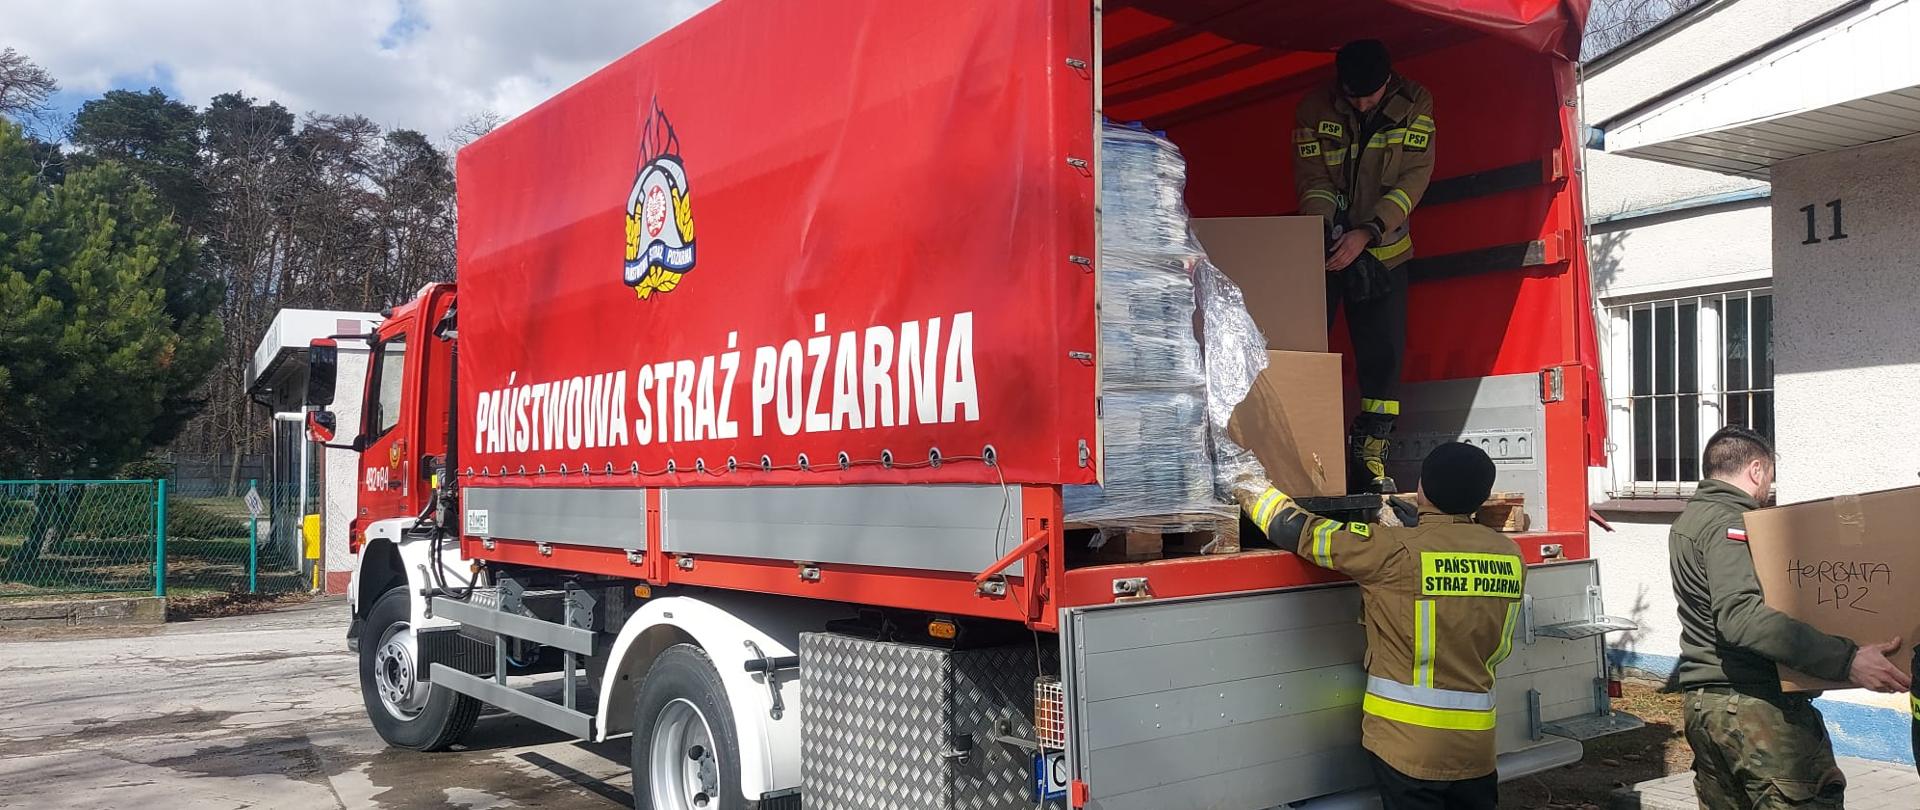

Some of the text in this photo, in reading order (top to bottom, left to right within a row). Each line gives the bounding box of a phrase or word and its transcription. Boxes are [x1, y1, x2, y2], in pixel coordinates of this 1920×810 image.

[1322, 122, 1340, 134] PSP
[1409, 134, 1426, 145] PSP
[1300, 144, 1317, 155] PSP
[1799, 199, 1848, 245] 11
[475, 311, 980, 454] PAŃSTWOWA STRAŻ POŻARNA
[1434, 556, 1514, 576] PAŃSTWOWA
